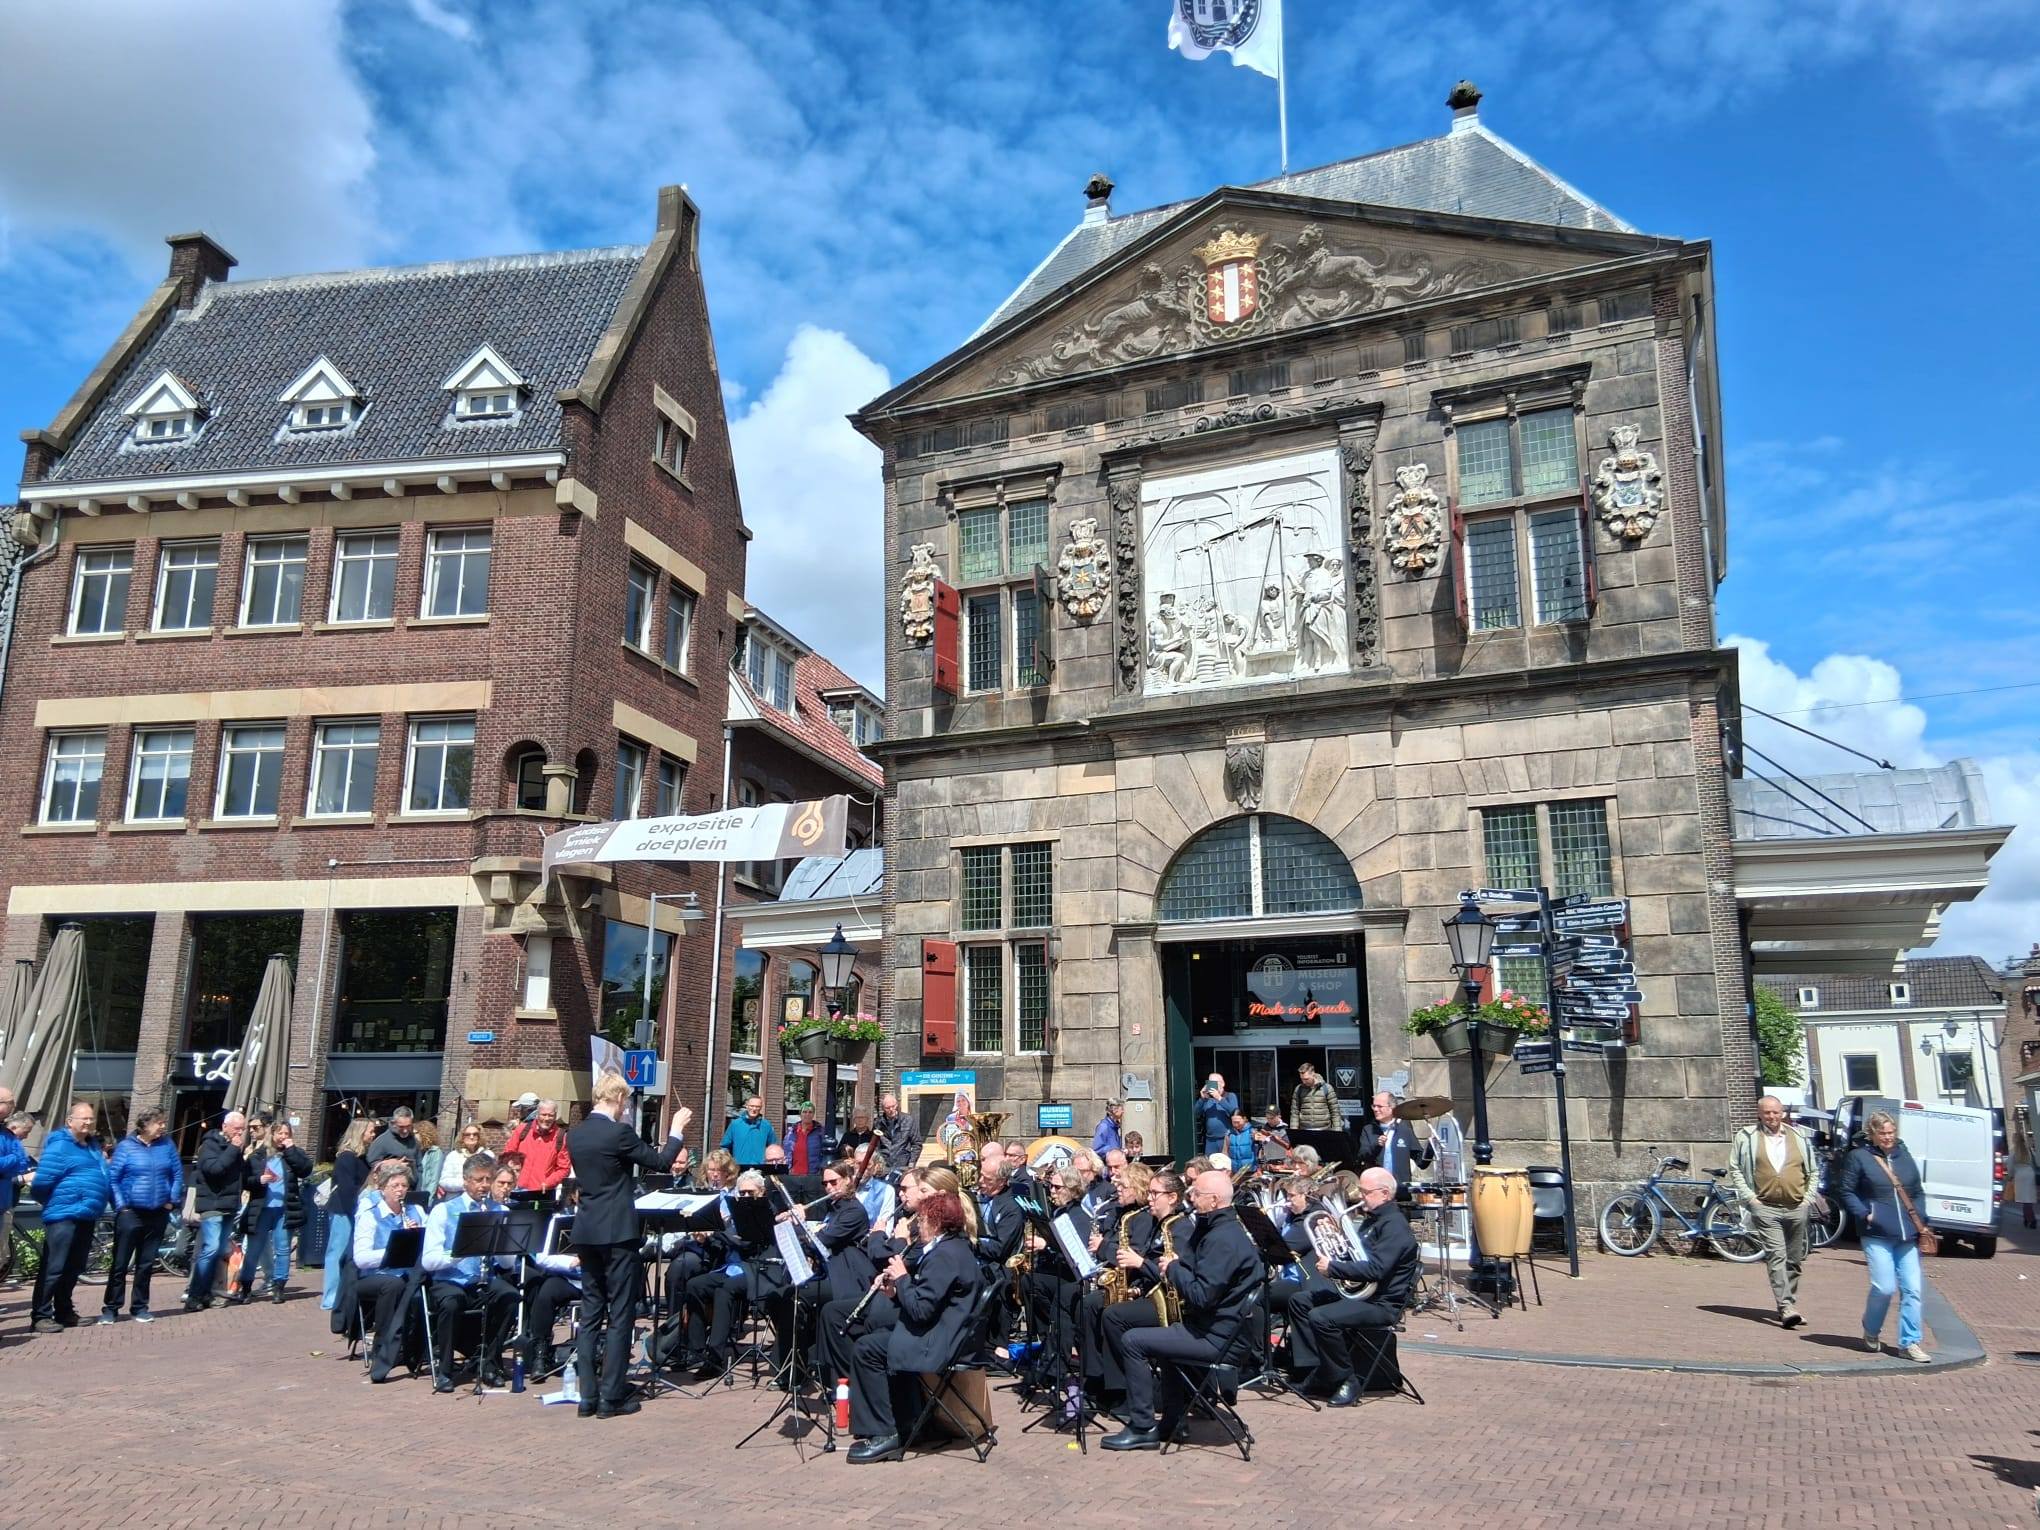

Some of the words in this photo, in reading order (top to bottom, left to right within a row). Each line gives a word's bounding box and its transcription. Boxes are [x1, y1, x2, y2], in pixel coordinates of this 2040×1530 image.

[648, 816, 743, 835] expositie
[636, 836, 727, 854] doeplein
[1297, 968, 1348, 979] MUSEUM
[1298, 982, 1307, 991] &
[1311, 981, 1343, 991] SHOP
[1248, 1001, 1285, 1015] Made
[1288, 1003, 1305, 1015] in
[1306, 1000, 1352, 1020] Gouda
